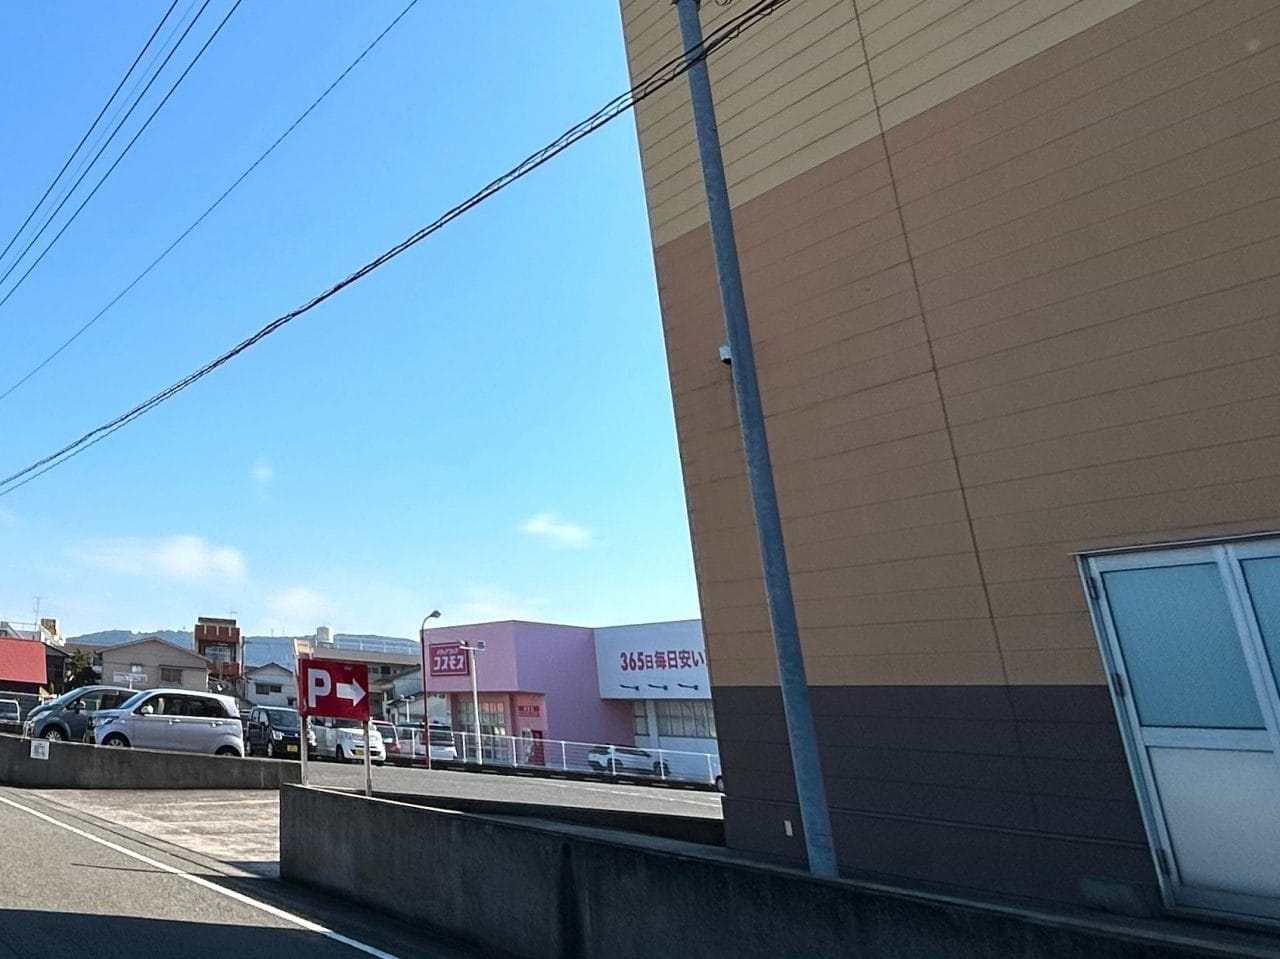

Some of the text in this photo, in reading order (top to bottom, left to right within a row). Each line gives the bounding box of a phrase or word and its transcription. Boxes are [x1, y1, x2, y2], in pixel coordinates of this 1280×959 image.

[433, 655, 464, 671] コスモス
[620, 649, 705, 671] 365日毎日安い
[307, 668, 331, 708] P
